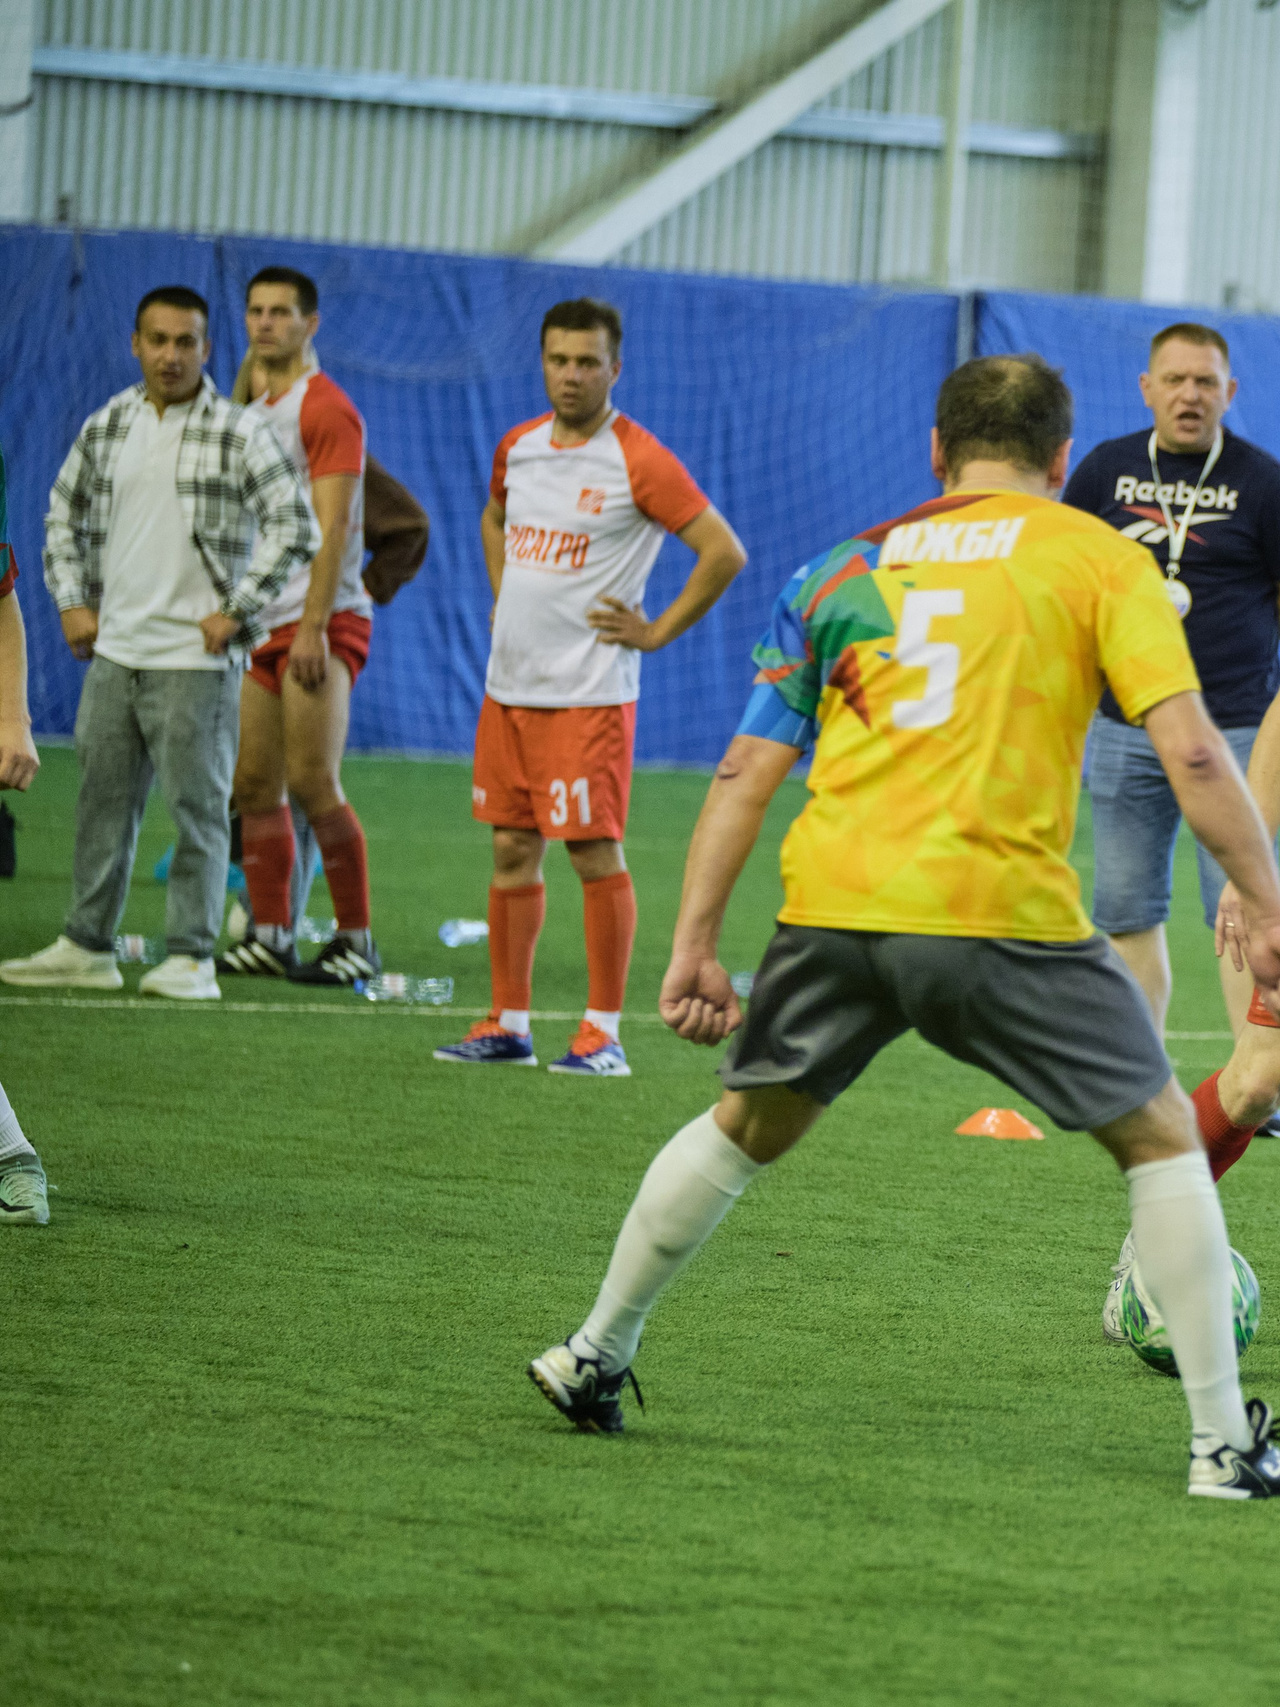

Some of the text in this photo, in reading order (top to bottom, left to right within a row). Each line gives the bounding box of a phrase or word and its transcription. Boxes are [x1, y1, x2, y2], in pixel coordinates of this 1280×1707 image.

[1115, 475, 1239, 511] Reebok
[892, 589, 964, 730] 5
[550, 777, 591, 827] 31
